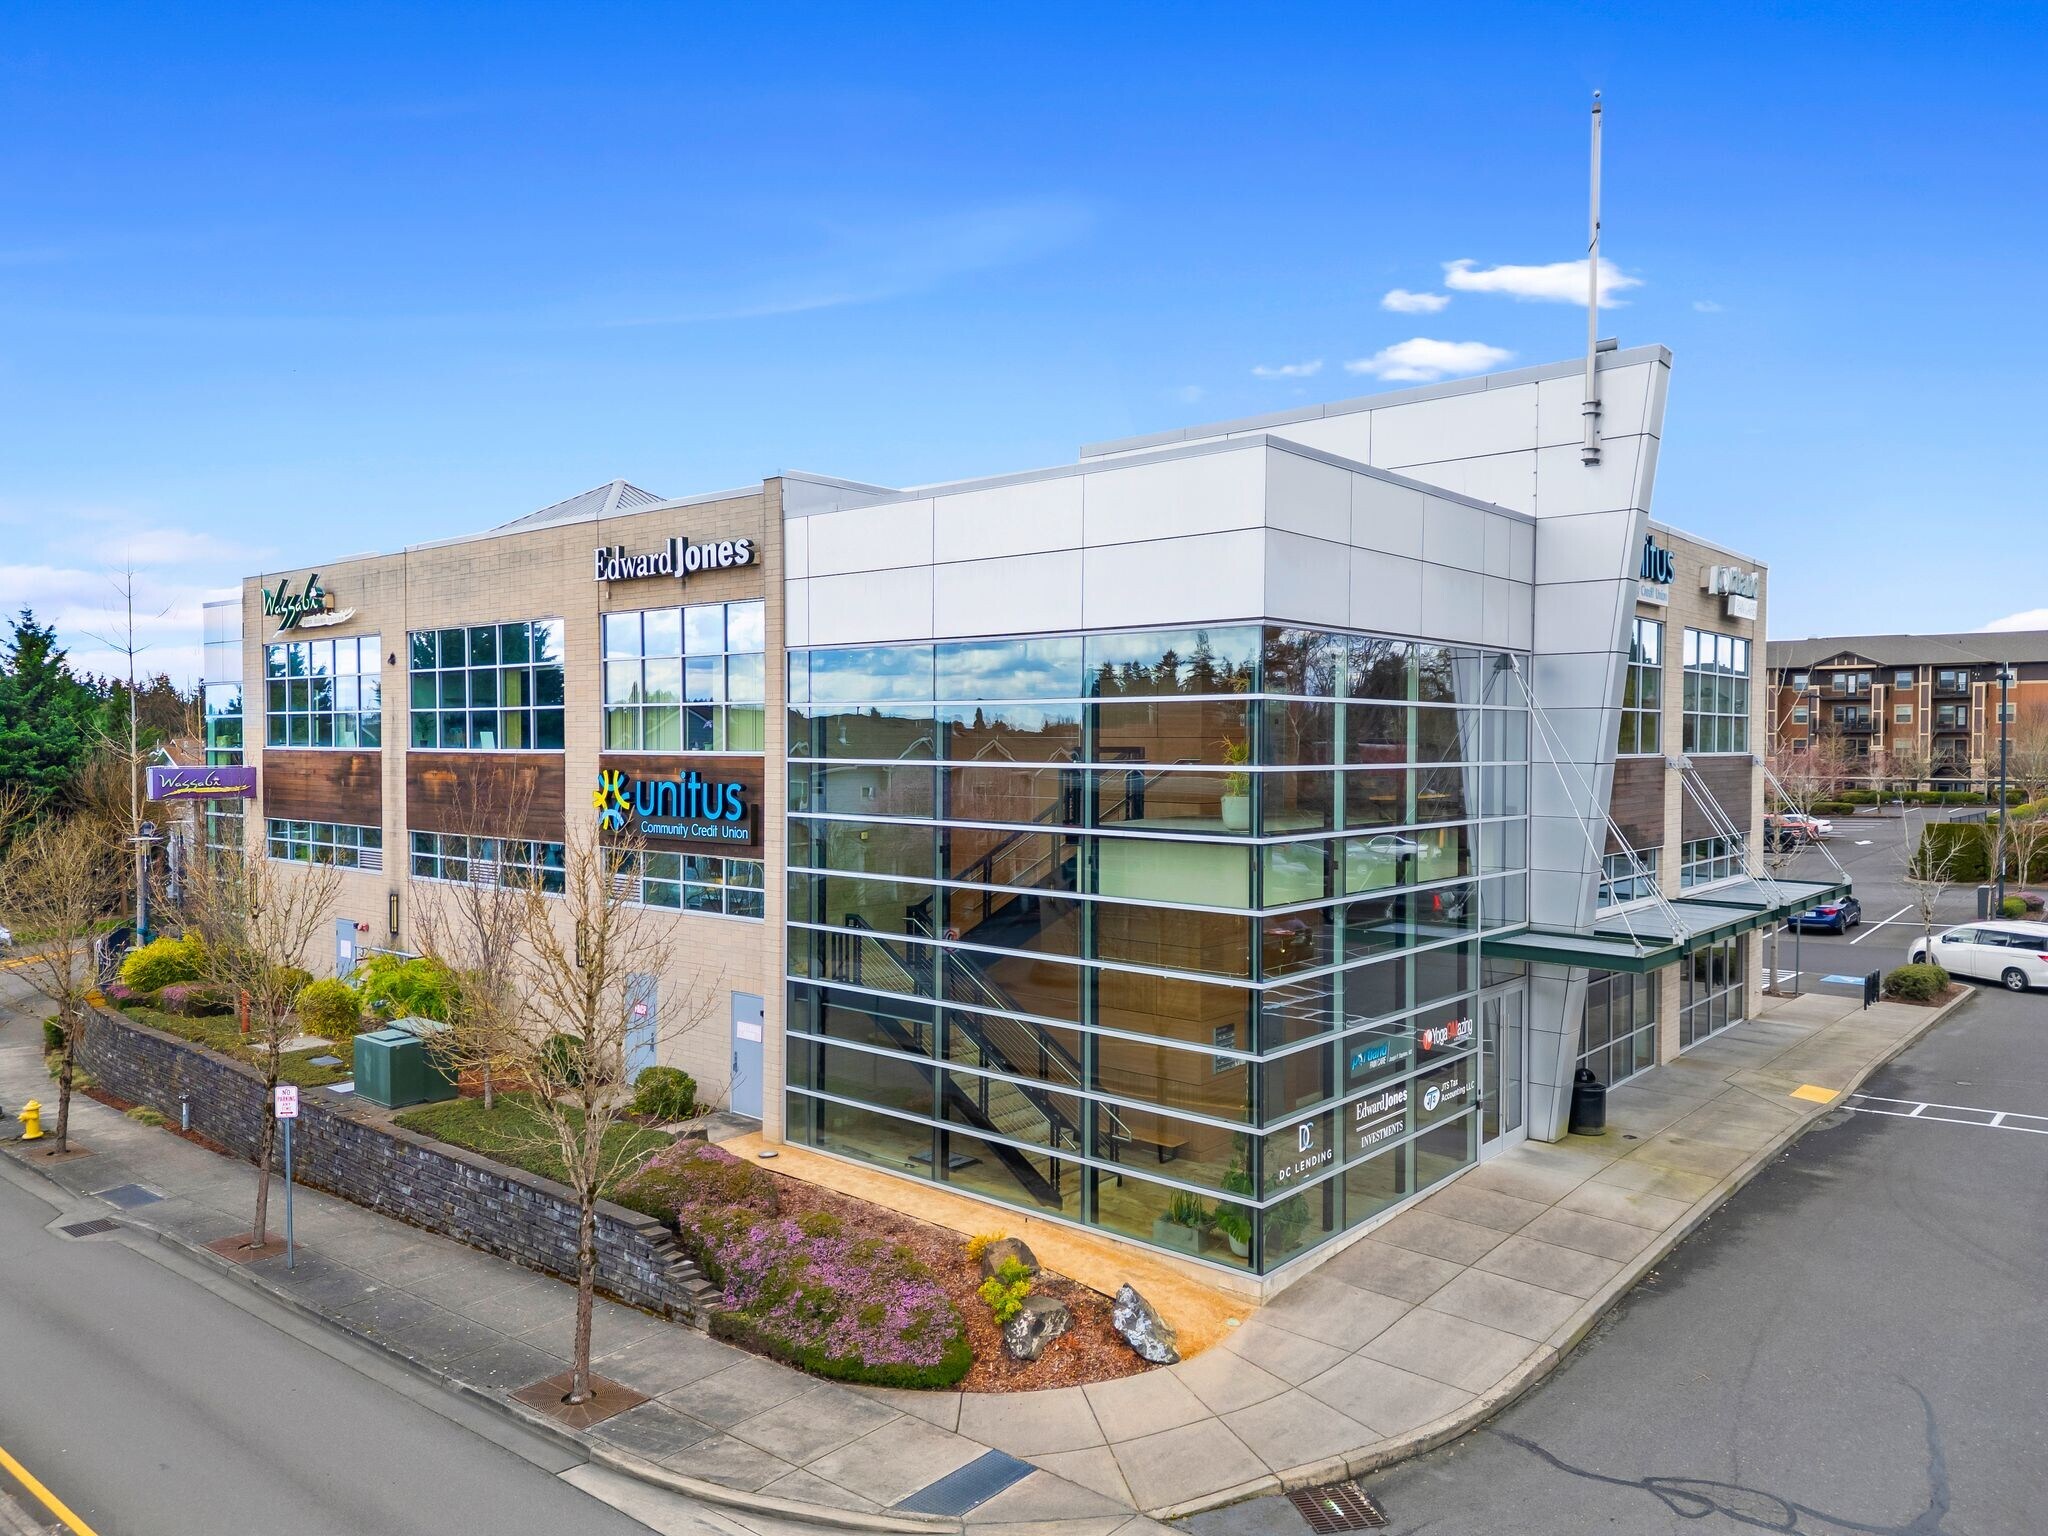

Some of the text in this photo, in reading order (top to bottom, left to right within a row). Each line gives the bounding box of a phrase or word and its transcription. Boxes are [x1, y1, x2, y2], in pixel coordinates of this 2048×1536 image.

[1640, 533, 1675, 584] itus
[261, 573, 320, 638] Wassabi
[159, 771, 221, 788] Wassabi
[635, 771, 742, 822] unitus
[641, 821, 748, 839] Community Credit Union
[1441, 1080, 1475, 1102] Accounting LLC
[1450, 1079, 1459, 1088] Tax
[1361, 1120, 1404, 1149] INVESTMENTS
[1279, 1149, 1333, 1181] DC LENDING
